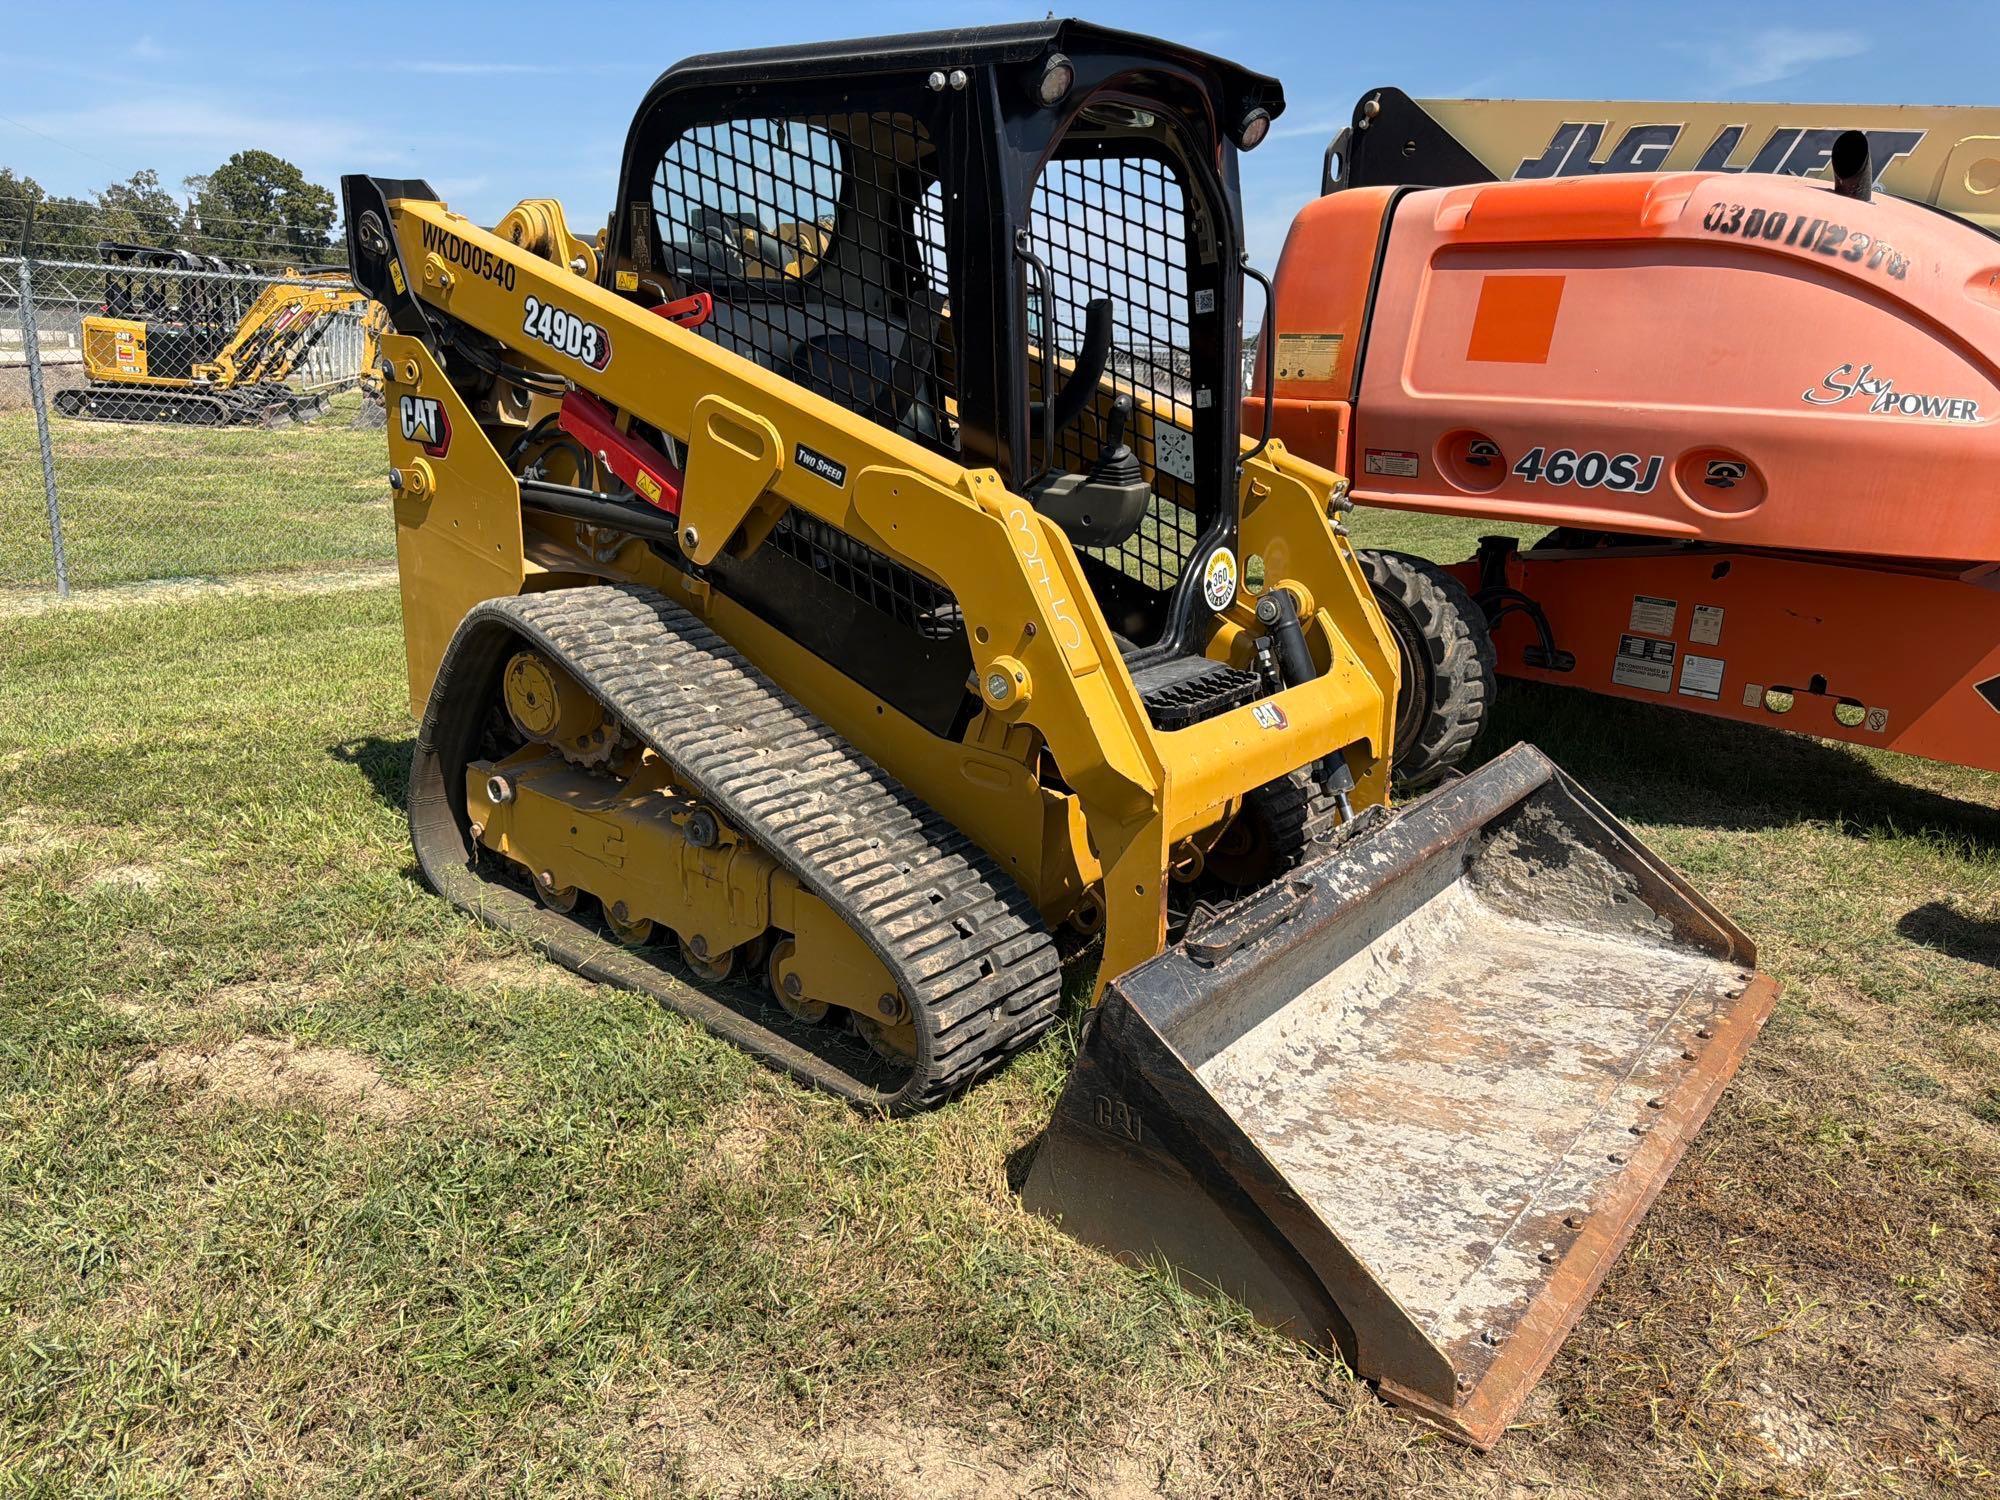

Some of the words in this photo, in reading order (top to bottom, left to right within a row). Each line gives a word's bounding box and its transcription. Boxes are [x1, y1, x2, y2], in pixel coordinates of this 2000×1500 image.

[1511, 121, 1685, 181] JLG
[1690, 124, 1930, 187] LIFT
[421, 219, 516, 292] WKD00540
[524, 296, 599, 364] 249D3
[400, 395, 438, 444] CAT
[1512, 447, 1664, 494] 460SJ
[1213, 568, 1228, 587] 360
[1251, 702, 1280, 729] CAT
[1093, 1094, 1142, 1143] CAT
